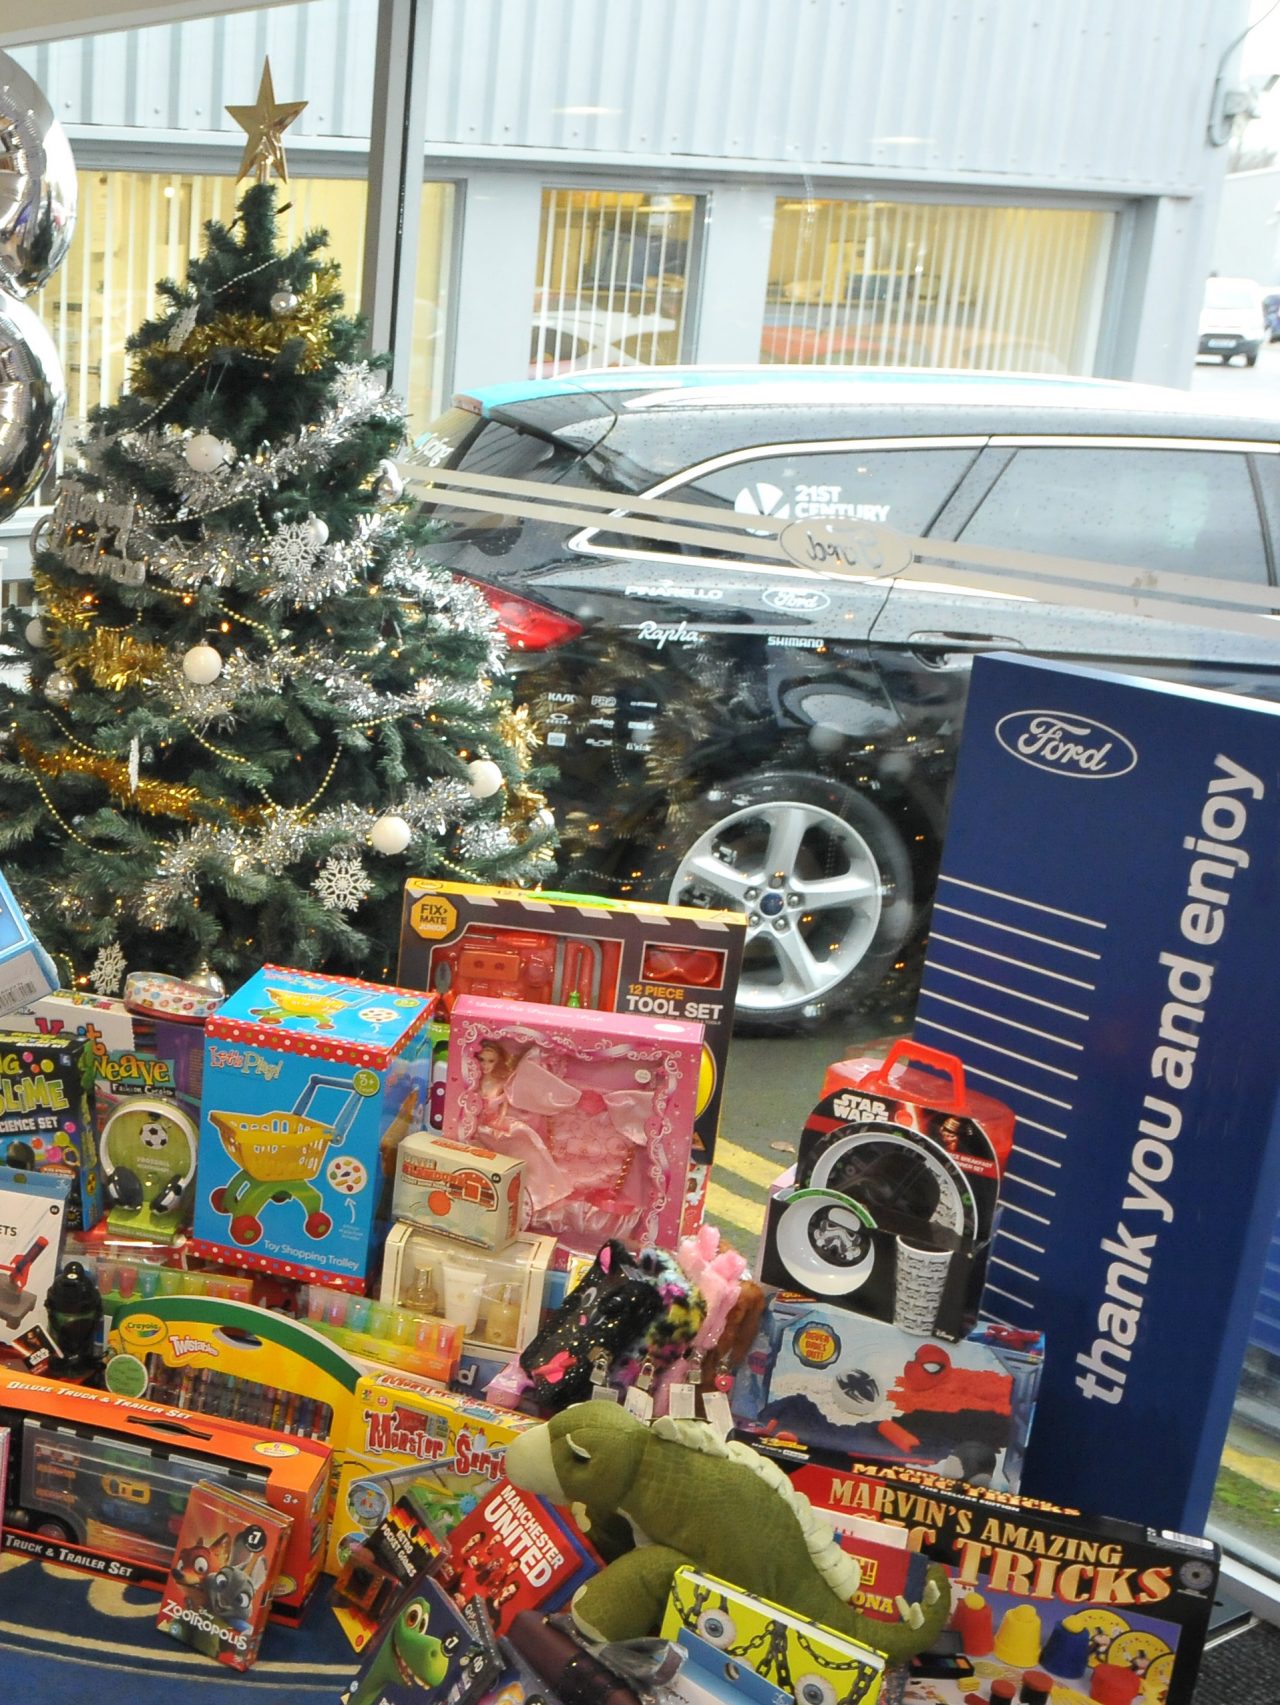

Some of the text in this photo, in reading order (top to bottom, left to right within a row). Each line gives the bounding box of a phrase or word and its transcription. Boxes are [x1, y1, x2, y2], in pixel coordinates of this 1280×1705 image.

[794, 485, 842, 503] 21ST
[794, 502, 891, 522] CENTURY
[624, 585, 723, 600] PINARELLO
[637, 620, 699, 650] Rapha
[767, 635, 825, 649] SHIMANO
[1016, 716, 1113, 772] Ford
[419, 914, 448, 926] MATE
[628, 984, 685, 1000] 12 PIECE
[626, 995, 680, 1016] TOOL
[684, 1001, 724, 1020] SET
[1075, 753, 1265, 1406] thank you and enjoy
[833, 1093, 888, 1116] STAR
[38, 1116, 59, 1130] SET
[264, 1239, 360, 1271] Toy Shopping Trolley
[127, 1322, 159, 1331] Crayola
[364, 1410, 446, 1460] Monster
[283, 1493, 299, 1505] 3+
[978, 1500, 1020, 1512] EDITION
[501, 1484, 565, 1571] MANCHESTER
[829, 1477, 974, 1535] MARVIN'S
[981, 1516, 1124, 1567] AMAZING
[379, 1523, 400, 1553] POCKET
[396, 1530, 414, 1555] RETRO
[483, 1495, 553, 1589] UNITED
[44, 1547, 55, 1559] &
[951, 1536, 1174, 1606] TRICKS
[162, 1599, 249, 1650] ZOOTROPOLIS
